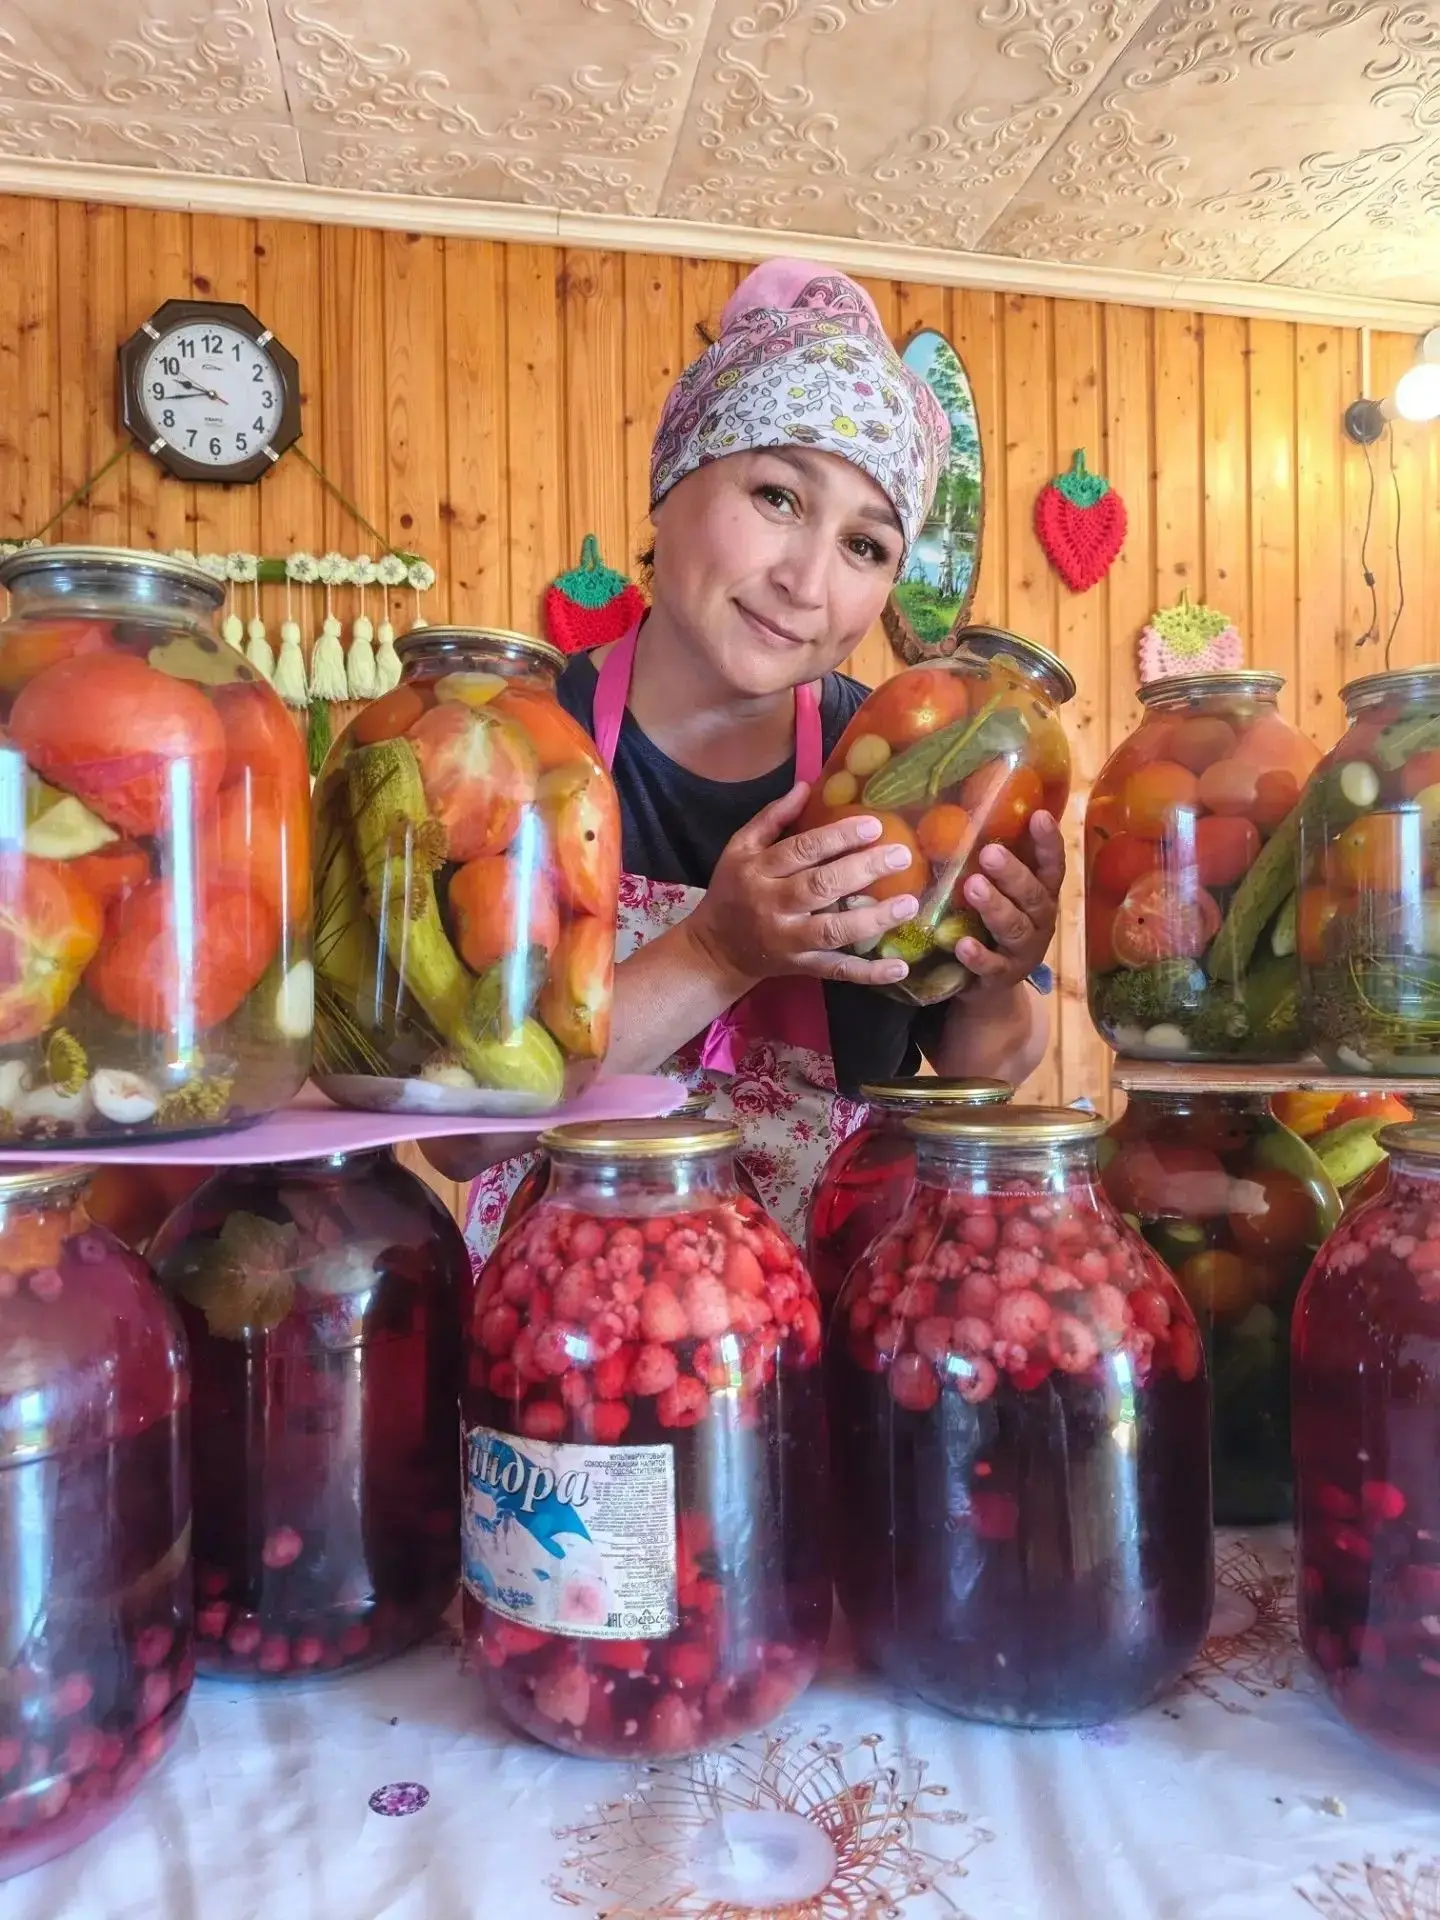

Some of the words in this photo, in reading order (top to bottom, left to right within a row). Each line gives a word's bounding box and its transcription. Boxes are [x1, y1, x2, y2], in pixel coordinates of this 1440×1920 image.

[177, 339, 195, 358] 11
[201, 335, 223, 354] 12
[232, 343, 240, 362] 1
[159, 356, 180, 375] 10
[252, 363, 264, 382] 2
[152, 382, 165, 401] 9
[261, 390, 273, 409] 3
[163, 409, 175, 428] 8
[252, 416, 265, 434] 4
[186, 429, 198, 447] 7
[209, 437, 222, 456] 6
[235, 432, 248, 451] 5
